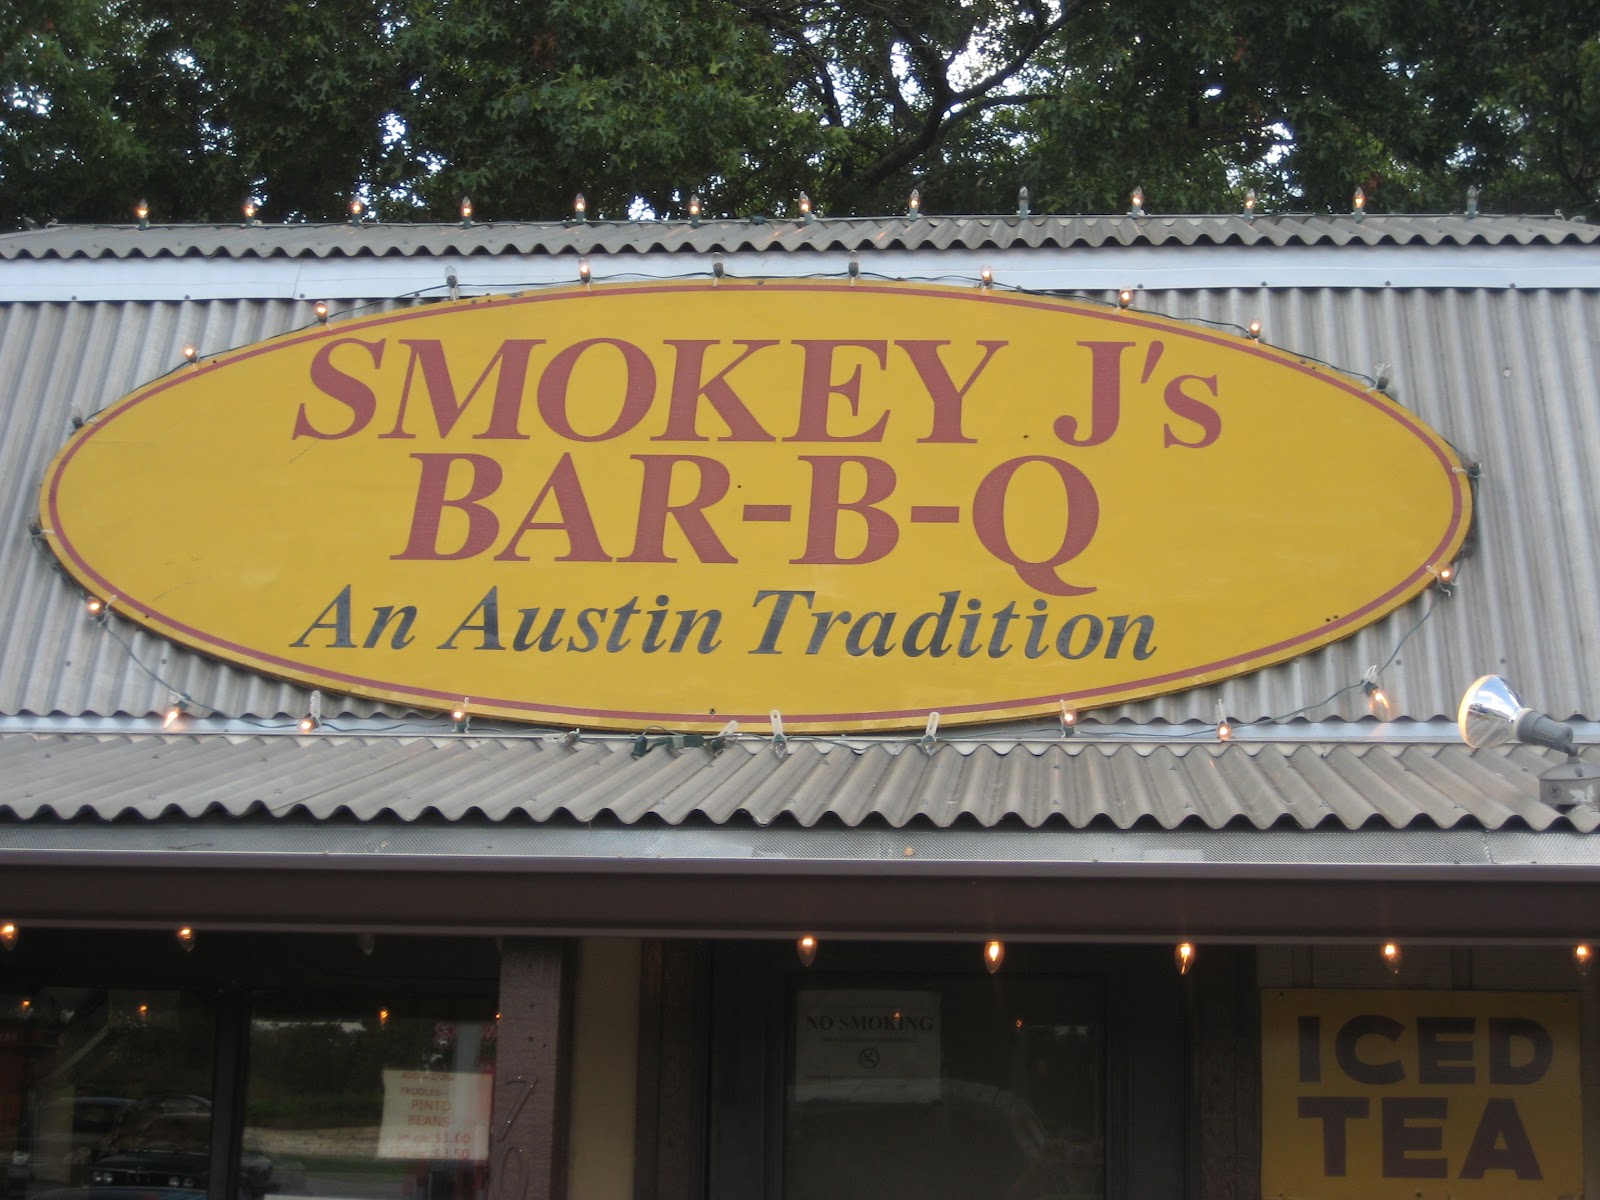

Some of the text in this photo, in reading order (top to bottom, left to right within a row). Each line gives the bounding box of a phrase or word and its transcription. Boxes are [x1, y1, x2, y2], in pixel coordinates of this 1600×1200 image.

[292, 337, 1008, 442] SMOKEY
[389, 452, 1100, 597] BAR-B-Q
[289, 584, 1158, 660] An Austin Tradition
[806, 1016, 935, 1031] NO SMOKING
[1297, 1014, 1554, 1085] ICED
[411, 1099, 451, 1112] PINTO
[1297, 1096, 1544, 1181] TEA
